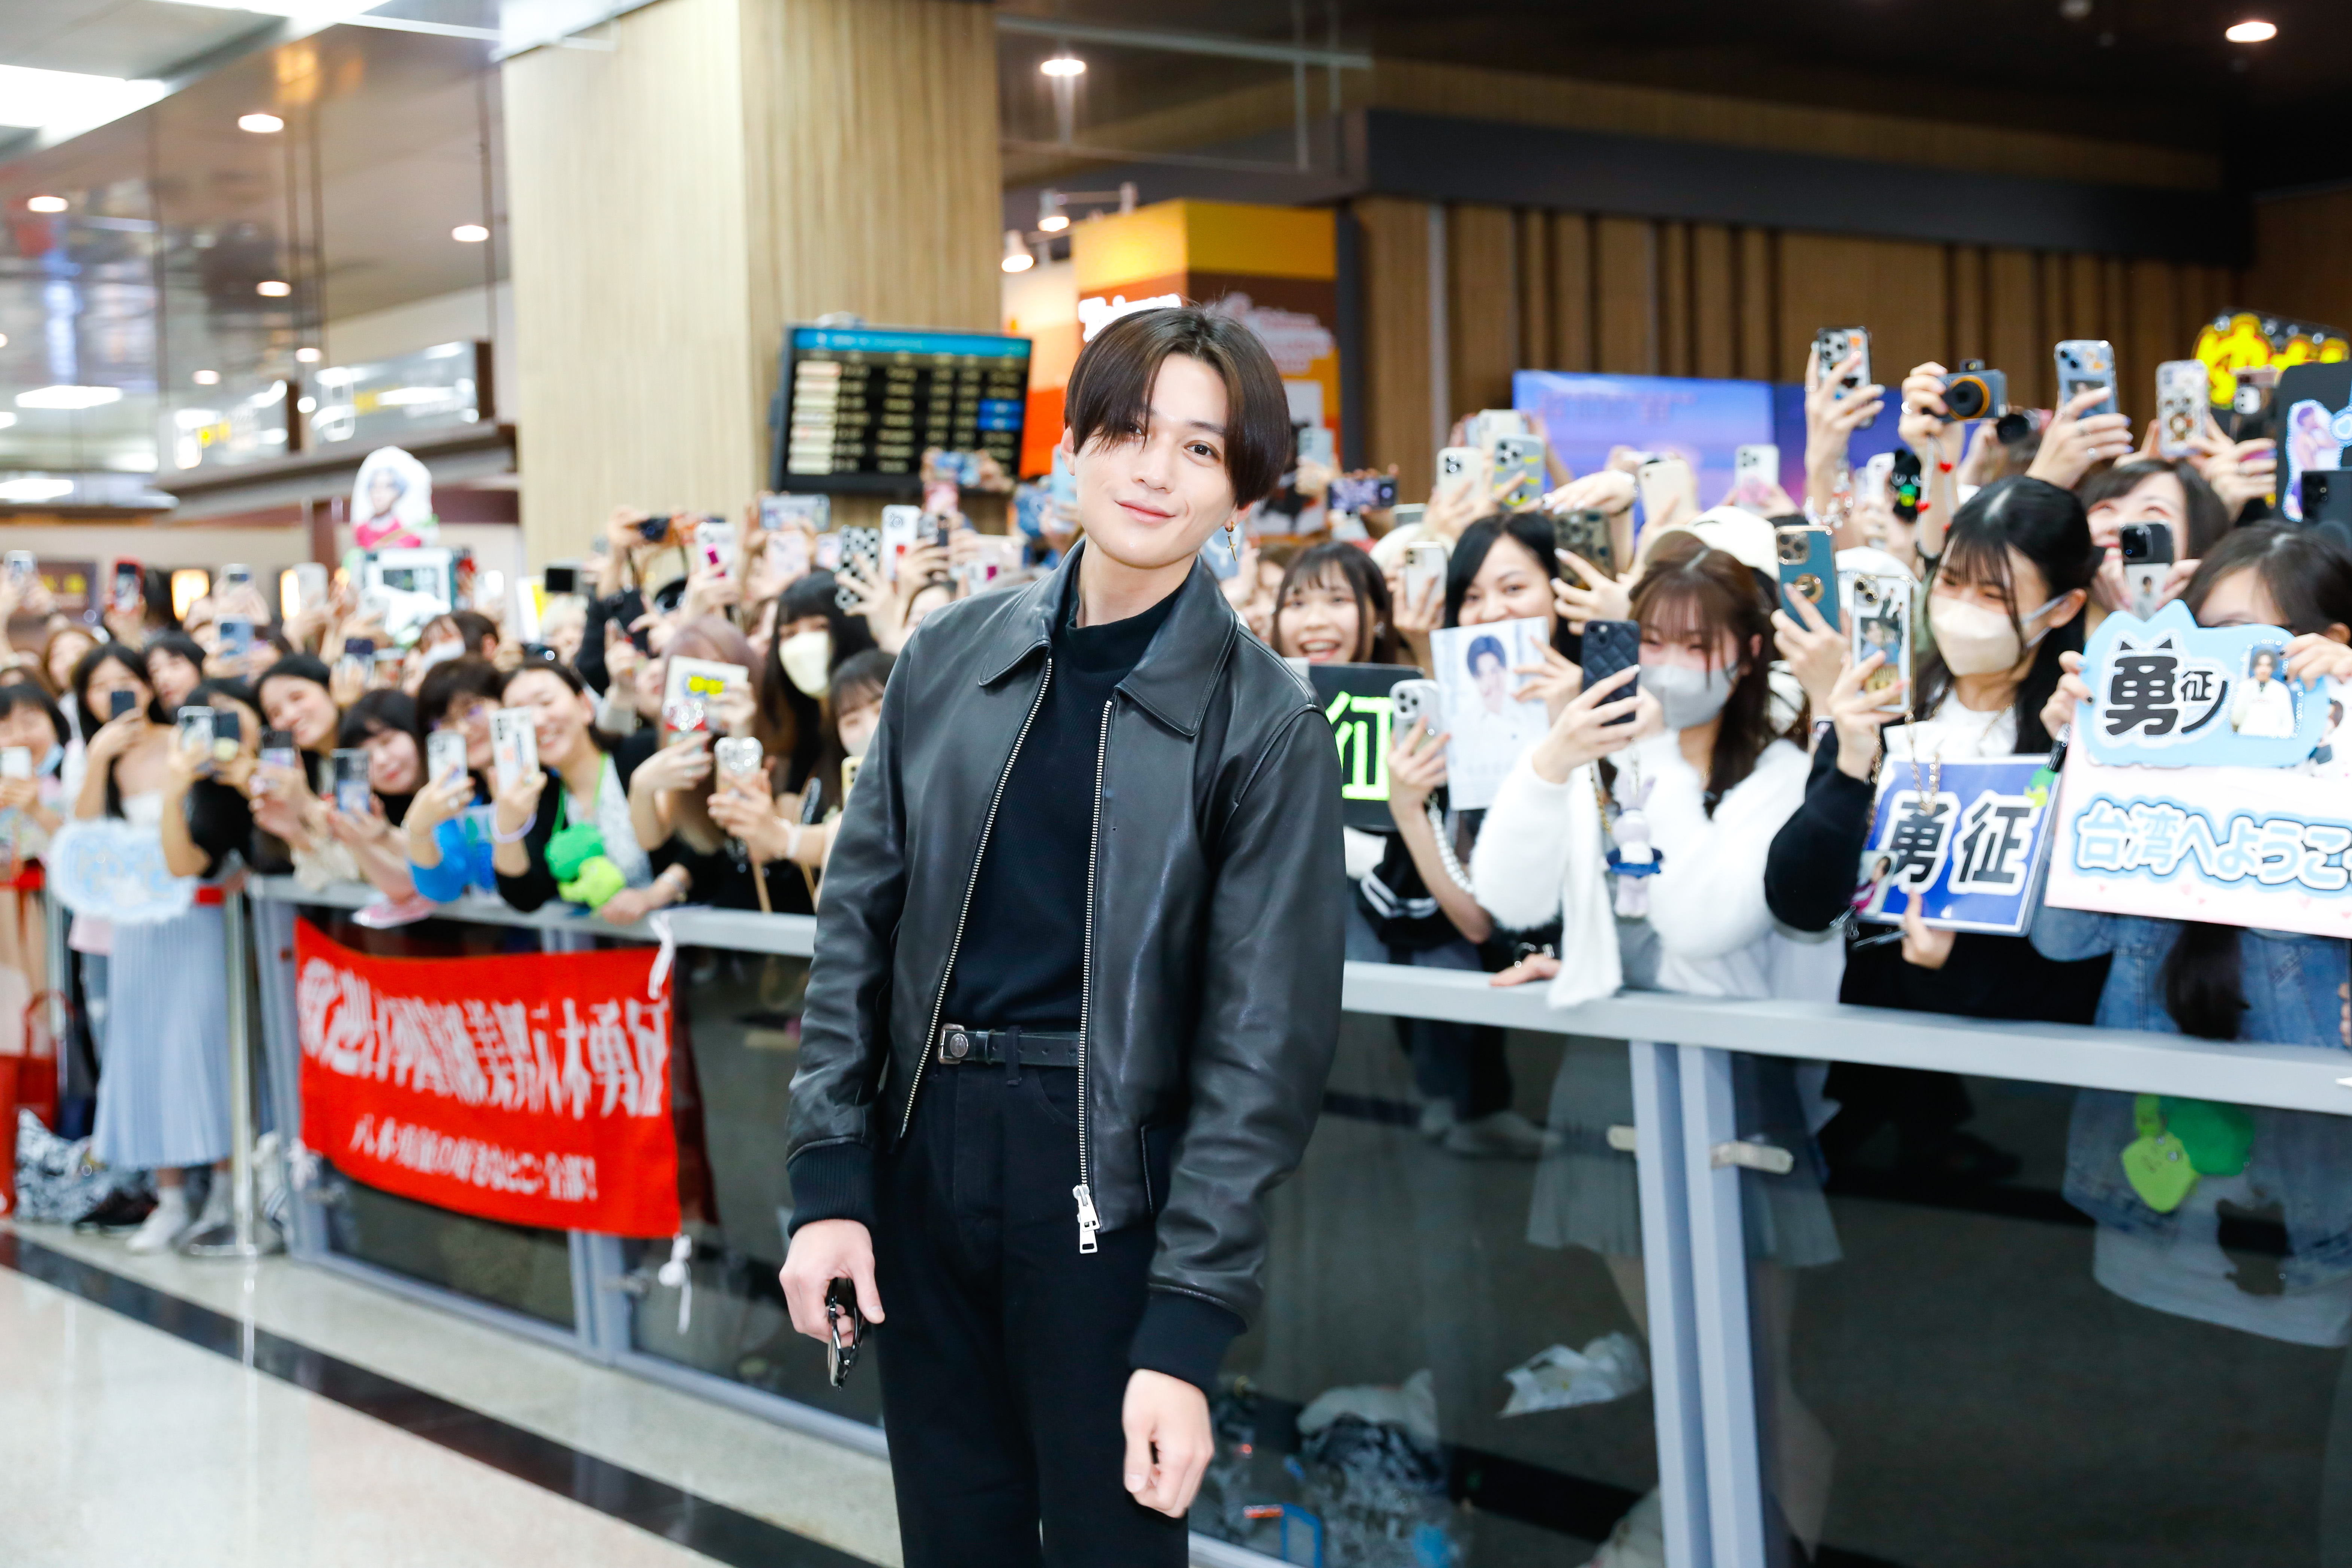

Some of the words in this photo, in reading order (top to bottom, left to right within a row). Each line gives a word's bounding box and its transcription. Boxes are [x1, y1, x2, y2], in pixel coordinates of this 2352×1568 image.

[1889, 800, 2035, 884] 勇征
[2078, 801, 2352, 889] 台湾へようこ
